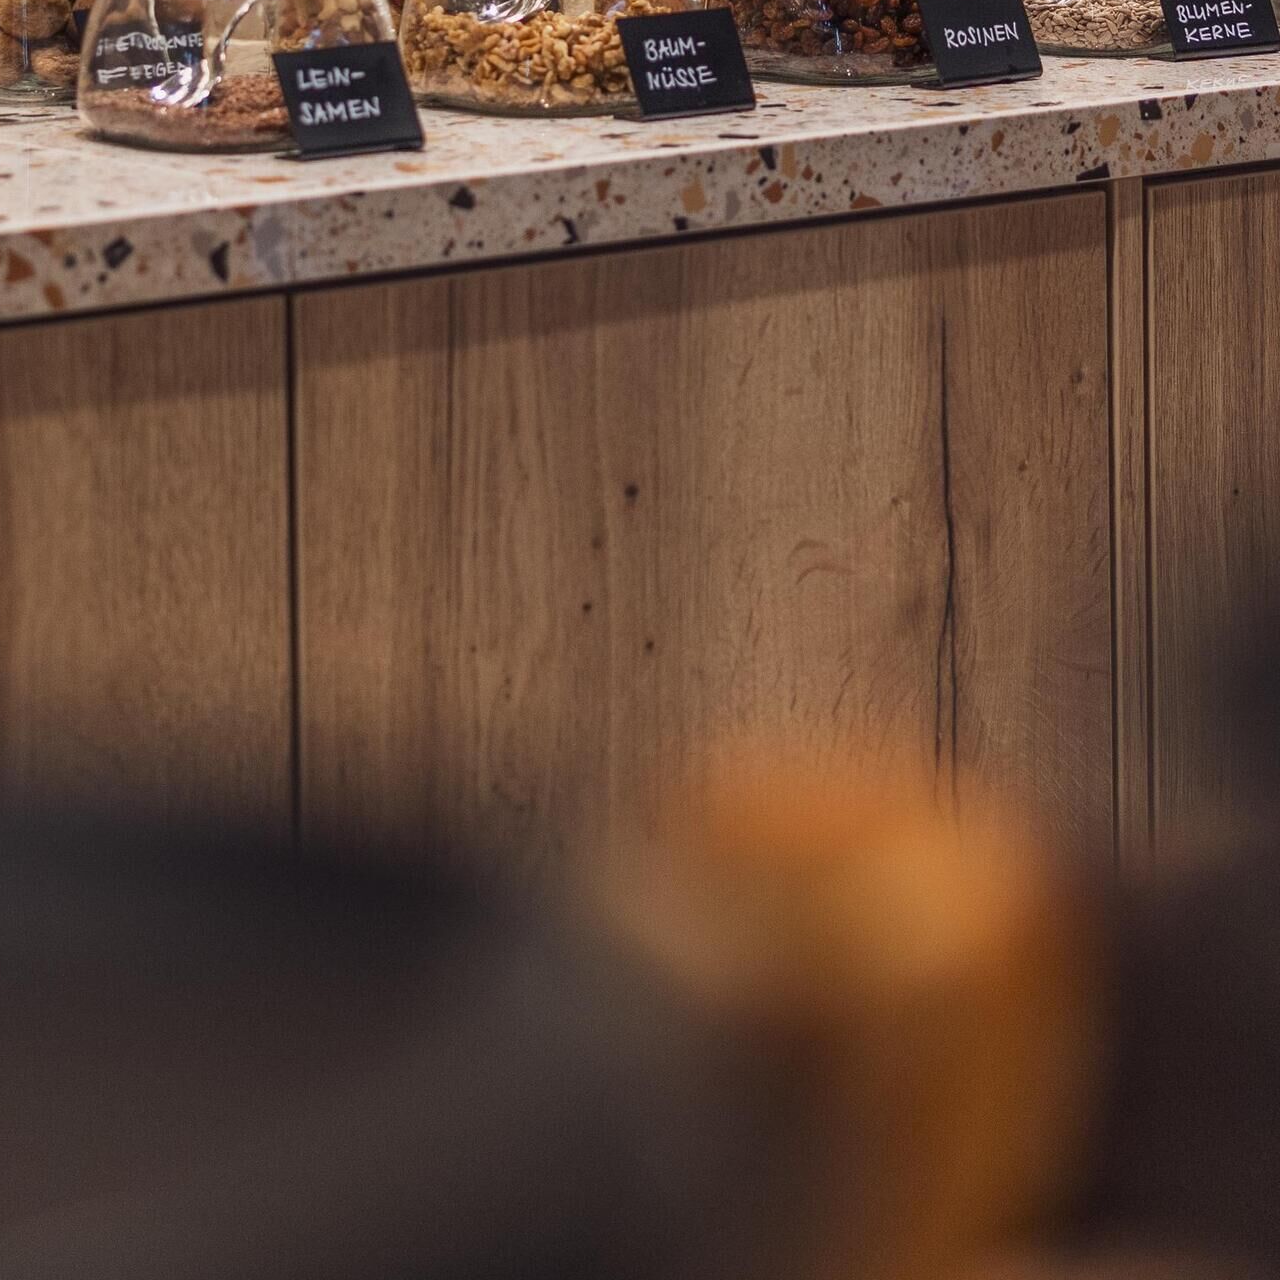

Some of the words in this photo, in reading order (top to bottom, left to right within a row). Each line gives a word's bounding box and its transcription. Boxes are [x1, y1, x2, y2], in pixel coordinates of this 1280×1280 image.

[1176, 0, 1252, 23] BLUMEN-
[943, 21, 1019, 48] ROSINEN
[1184, 22, 1253, 43] KERNE
[644, 36, 706, 61] BAUM-
[297, 66, 366, 90] LEIN-
[646, 65, 717, 90] NÜSSE
[300, 96, 381, 125] SAMEN
